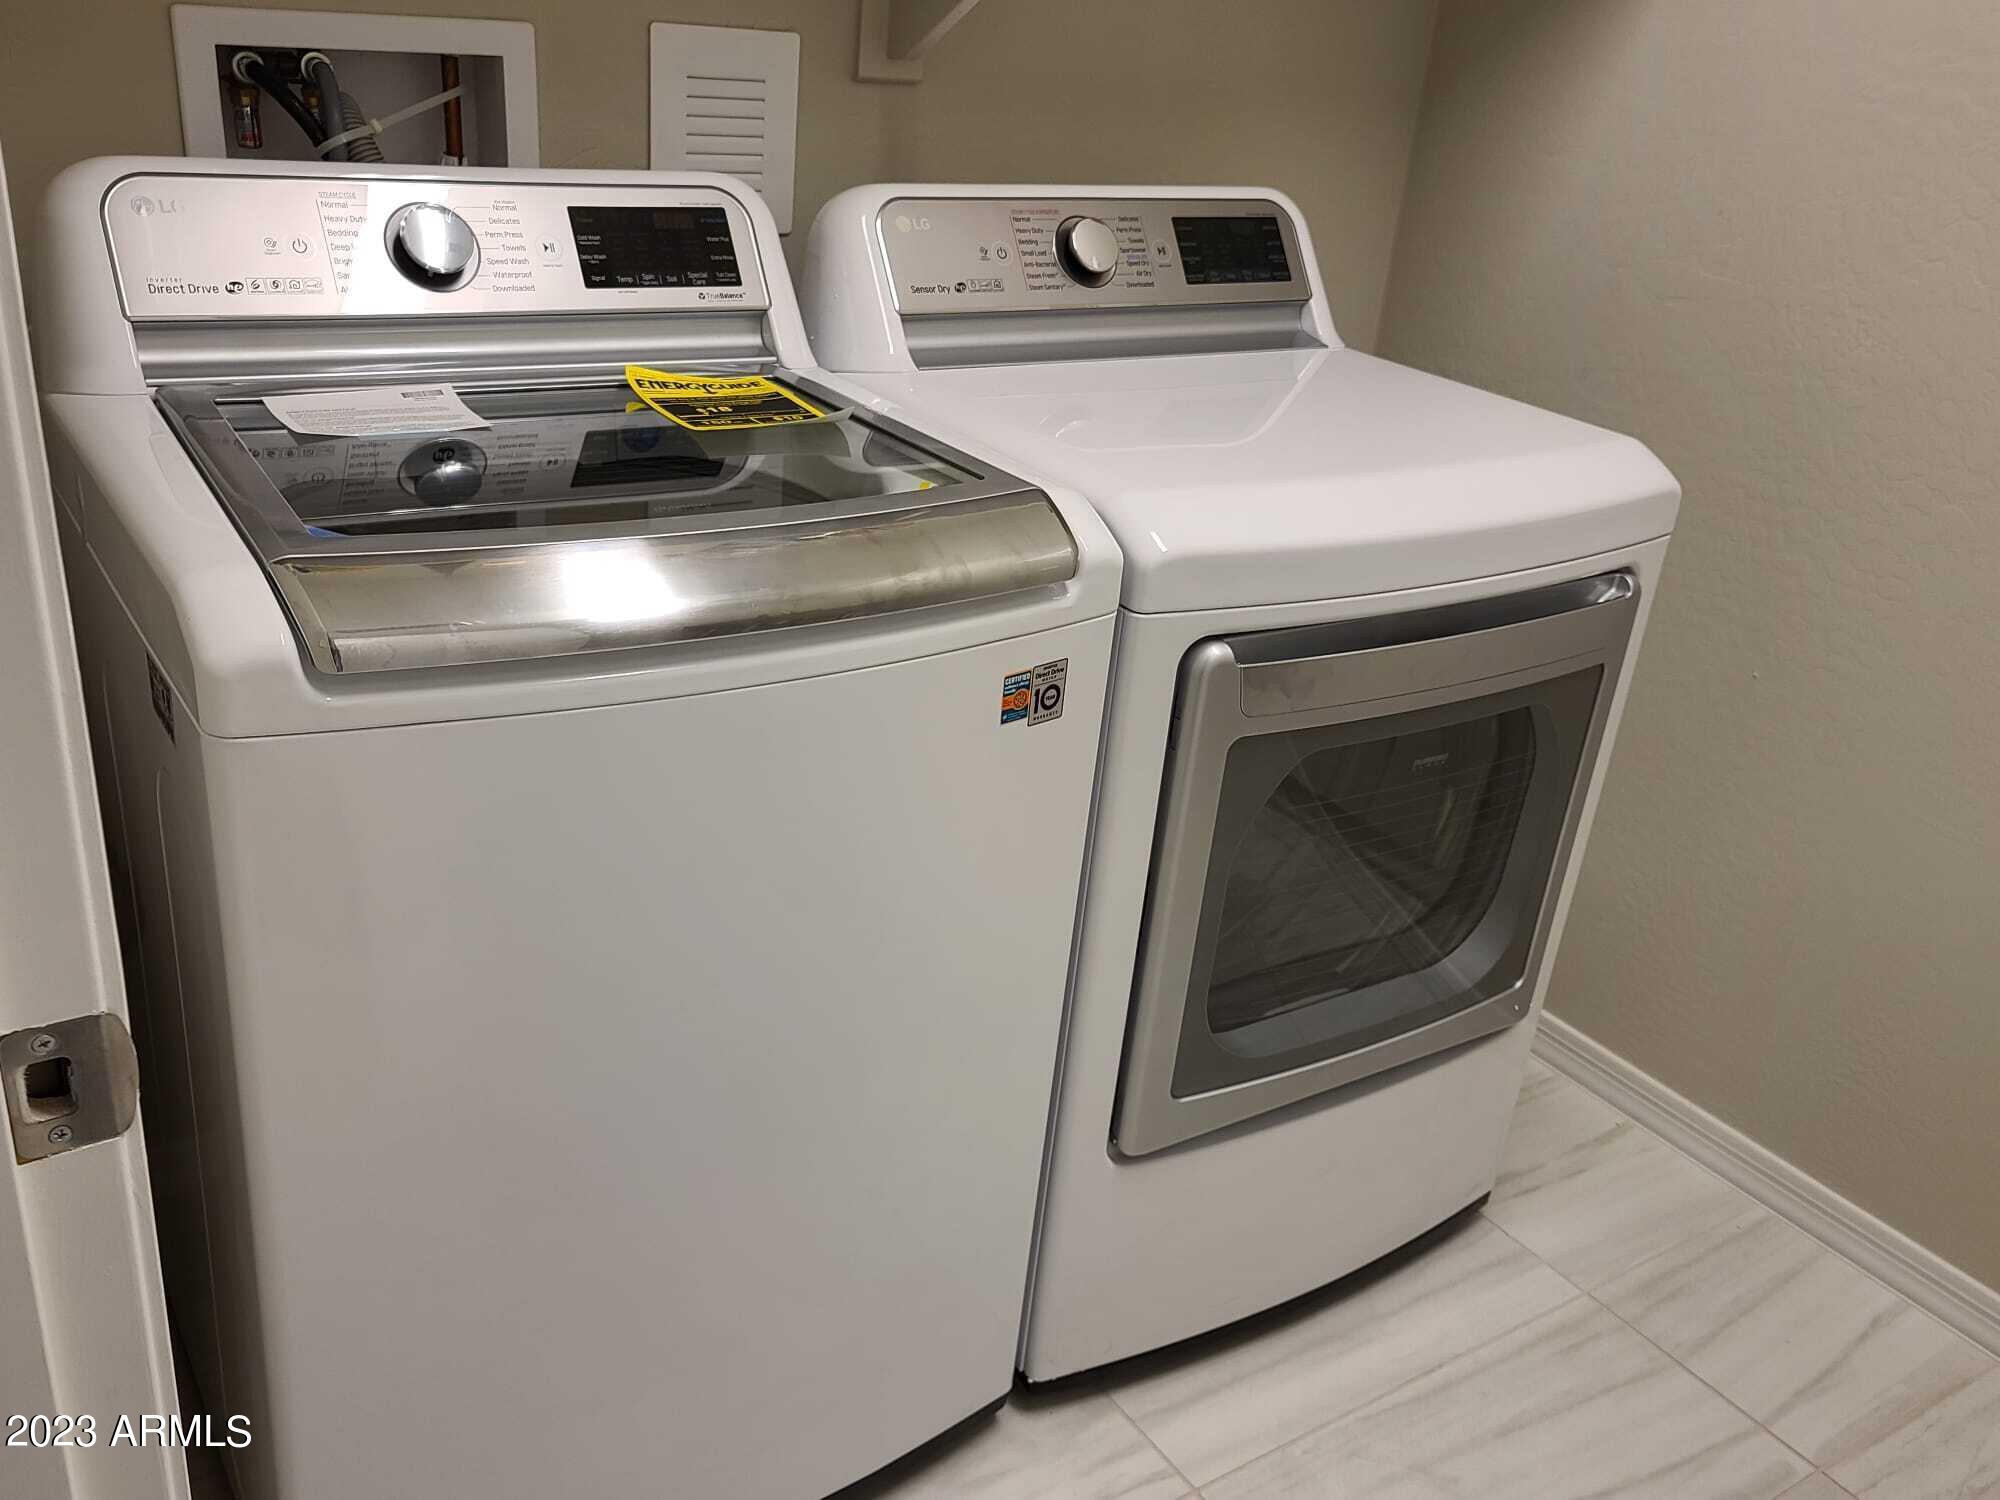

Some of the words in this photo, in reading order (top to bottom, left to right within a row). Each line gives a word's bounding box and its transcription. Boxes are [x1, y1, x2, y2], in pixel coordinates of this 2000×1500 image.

[320, 200, 349, 208] Normal
[492, 203, 518, 212] Normal
[323, 215, 348, 225] Heavy
[488, 217, 521, 225] Delicates
[912, 218, 930, 231] LG
[327, 229, 359, 240] Bedding
[485, 230, 503, 239] Perm
[504, 230, 524, 239] Press
[502, 244, 527, 252] Towels
[486, 257, 509, 267] Speed
[510, 257, 530, 265] Wash
[492, 271, 533, 280] Waterproof
[617, 276, 634, 285] Temp
[147, 283, 186, 295] Direct
[188, 283, 220, 295] Drive
[491, 284, 536, 293] Downloaded
[910, 284, 936, 294] Sensor
[936, 283, 951, 296] Dry
[1033, 684, 1061, 715] 10
